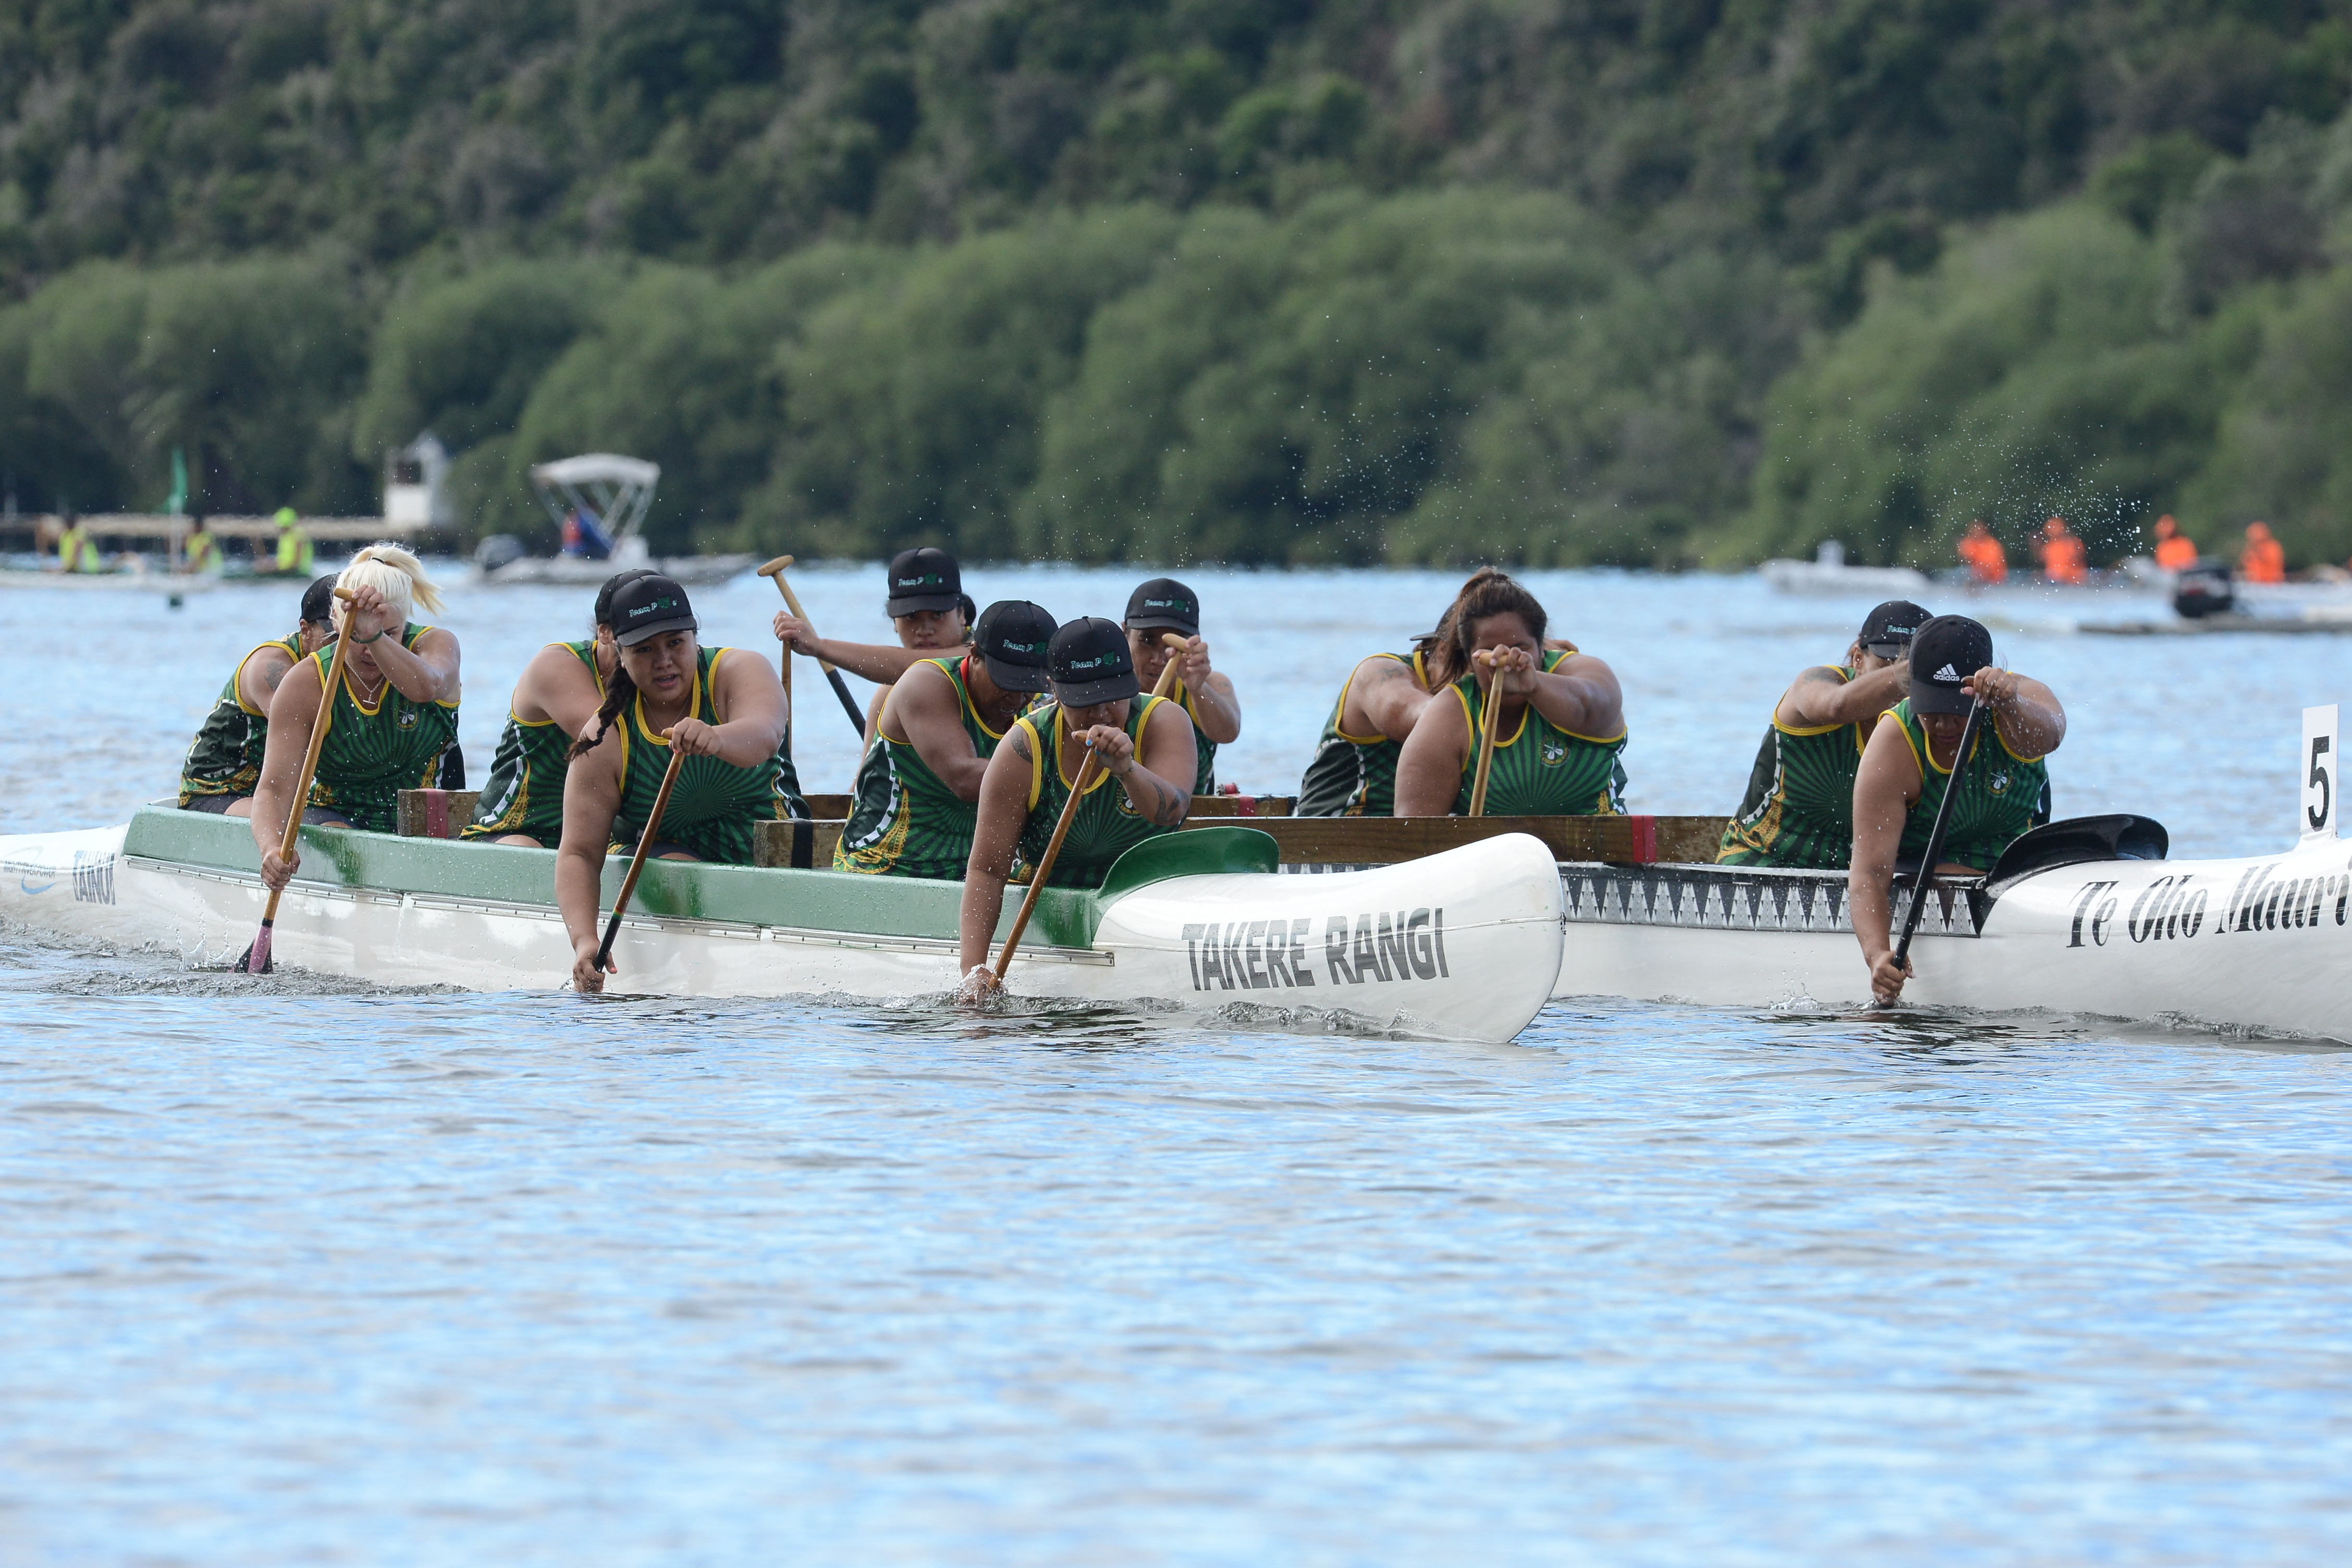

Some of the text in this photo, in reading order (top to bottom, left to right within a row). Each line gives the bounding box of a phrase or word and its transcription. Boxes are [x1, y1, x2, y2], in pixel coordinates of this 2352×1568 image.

[629, 607, 651, 617] Team
[1886, 625, 1909, 634] Team
[1003, 639, 1025, 652] Team
[1071, 660, 1094, 669] Team
[2308, 736, 2330, 831] 5
[2066, 880, 2120, 948] Te
[2214, 856, 2352, 934] Mauri
[1182, 907, 1449, 990] TAKERE RANGI
